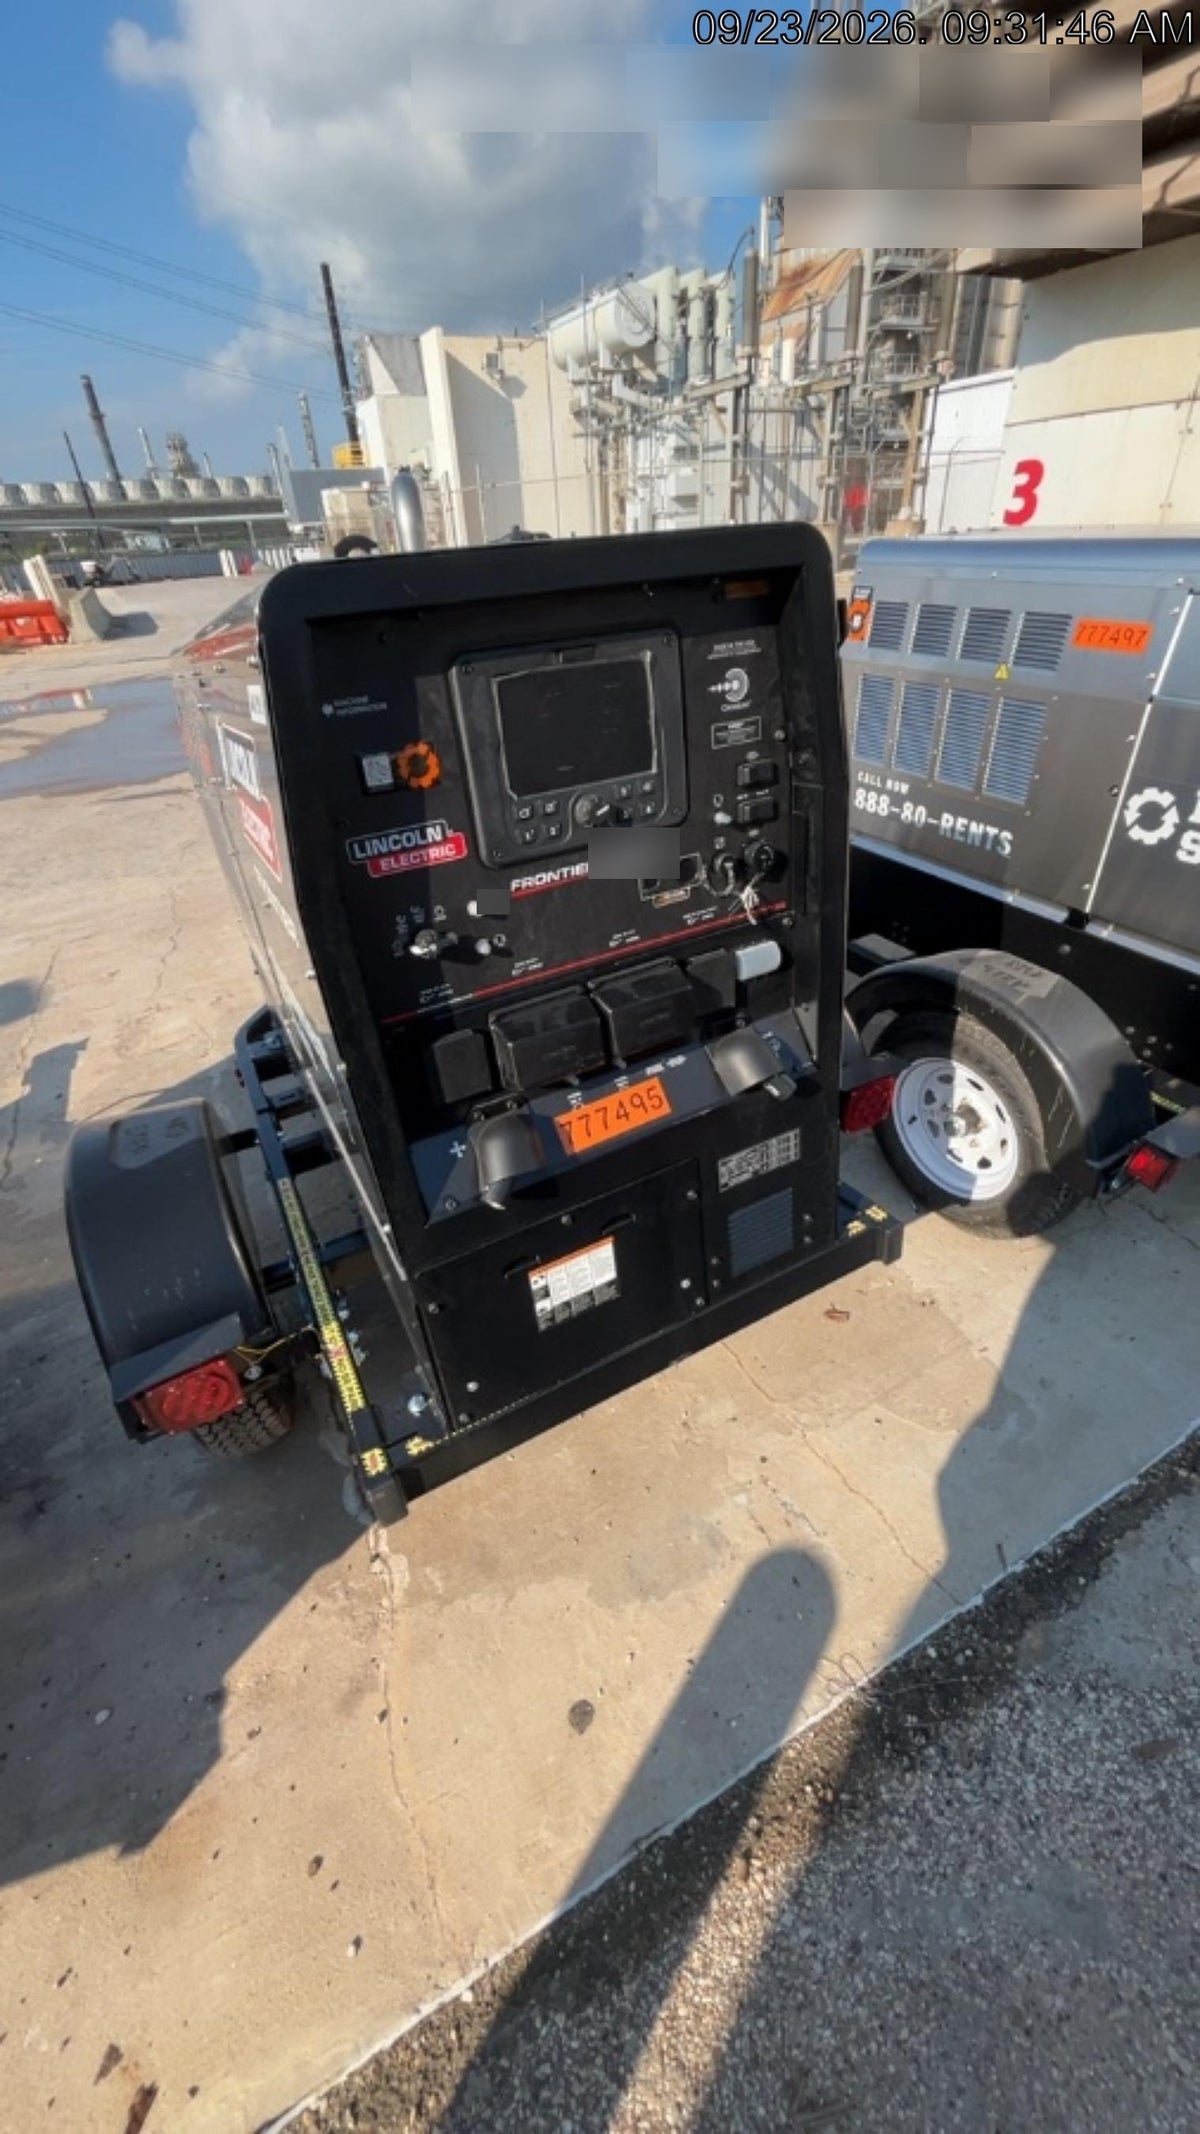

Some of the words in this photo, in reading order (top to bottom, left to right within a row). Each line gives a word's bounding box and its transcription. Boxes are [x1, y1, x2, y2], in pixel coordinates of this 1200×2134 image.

[1003, 459, 1044, 526] 3
[857, 770, 882, 788] CALL
[886, 778, 911, 794] NOW
[352, 823, 443, 860] LINCOLN
[855, 787, 1014, 858] 888-80-RENTS
[380, 843, 457, 871] ELECTRIC
[559, 1085, 664, 1148] 777495
